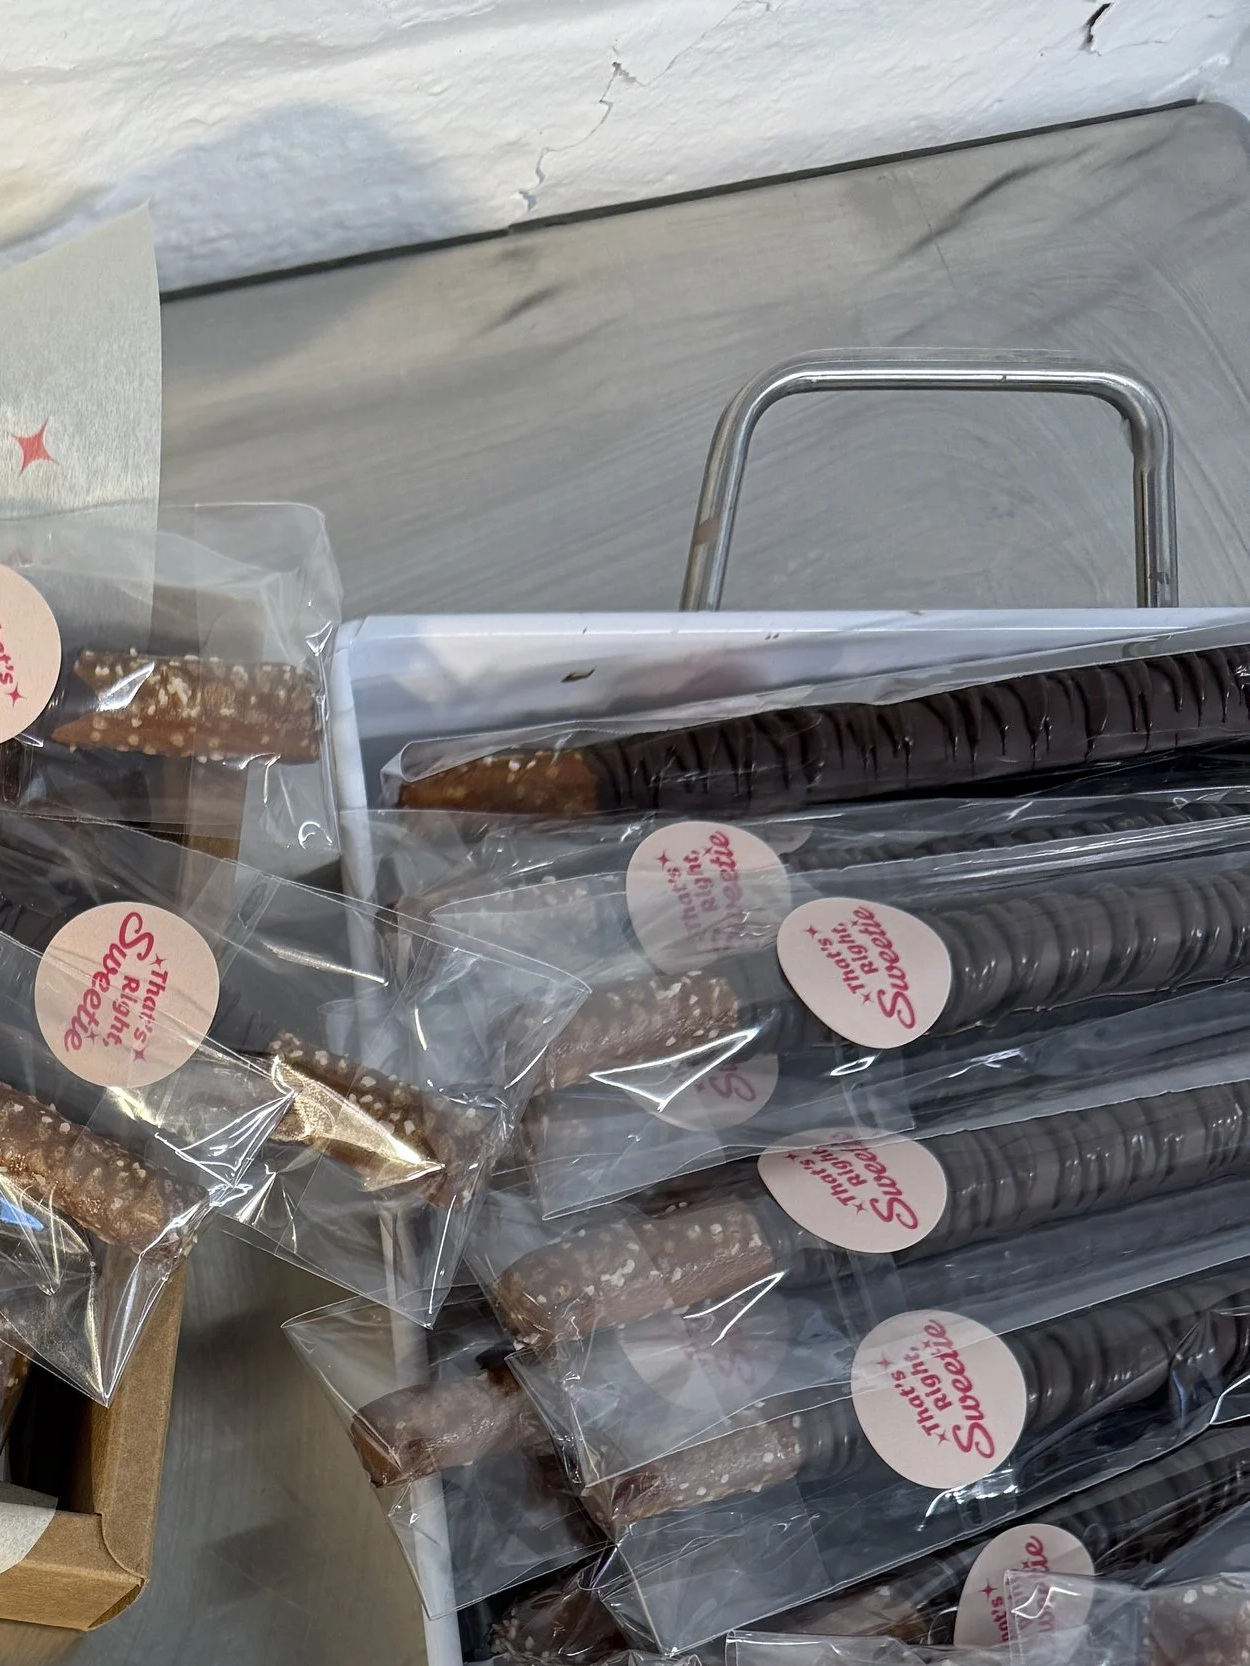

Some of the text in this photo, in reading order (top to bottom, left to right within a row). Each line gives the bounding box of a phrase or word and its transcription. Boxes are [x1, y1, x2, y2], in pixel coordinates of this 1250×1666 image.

[64, 912, 154, 1053] Sweetie
[818, 937, 862, 994] That's
[830, 923, 879, 976] Right,
[853, 906, 916, 1029] Sweetie
[102, 975, 140, 1046] Right,
[133, 969, 168, 1043] That's
[798, 1158, 849, 1206] That's
[890, 1369, 942, 1436] That's
[903, 1346, 953, 1411] Right,
[924, 1320, 995, 1459] Sweetie
